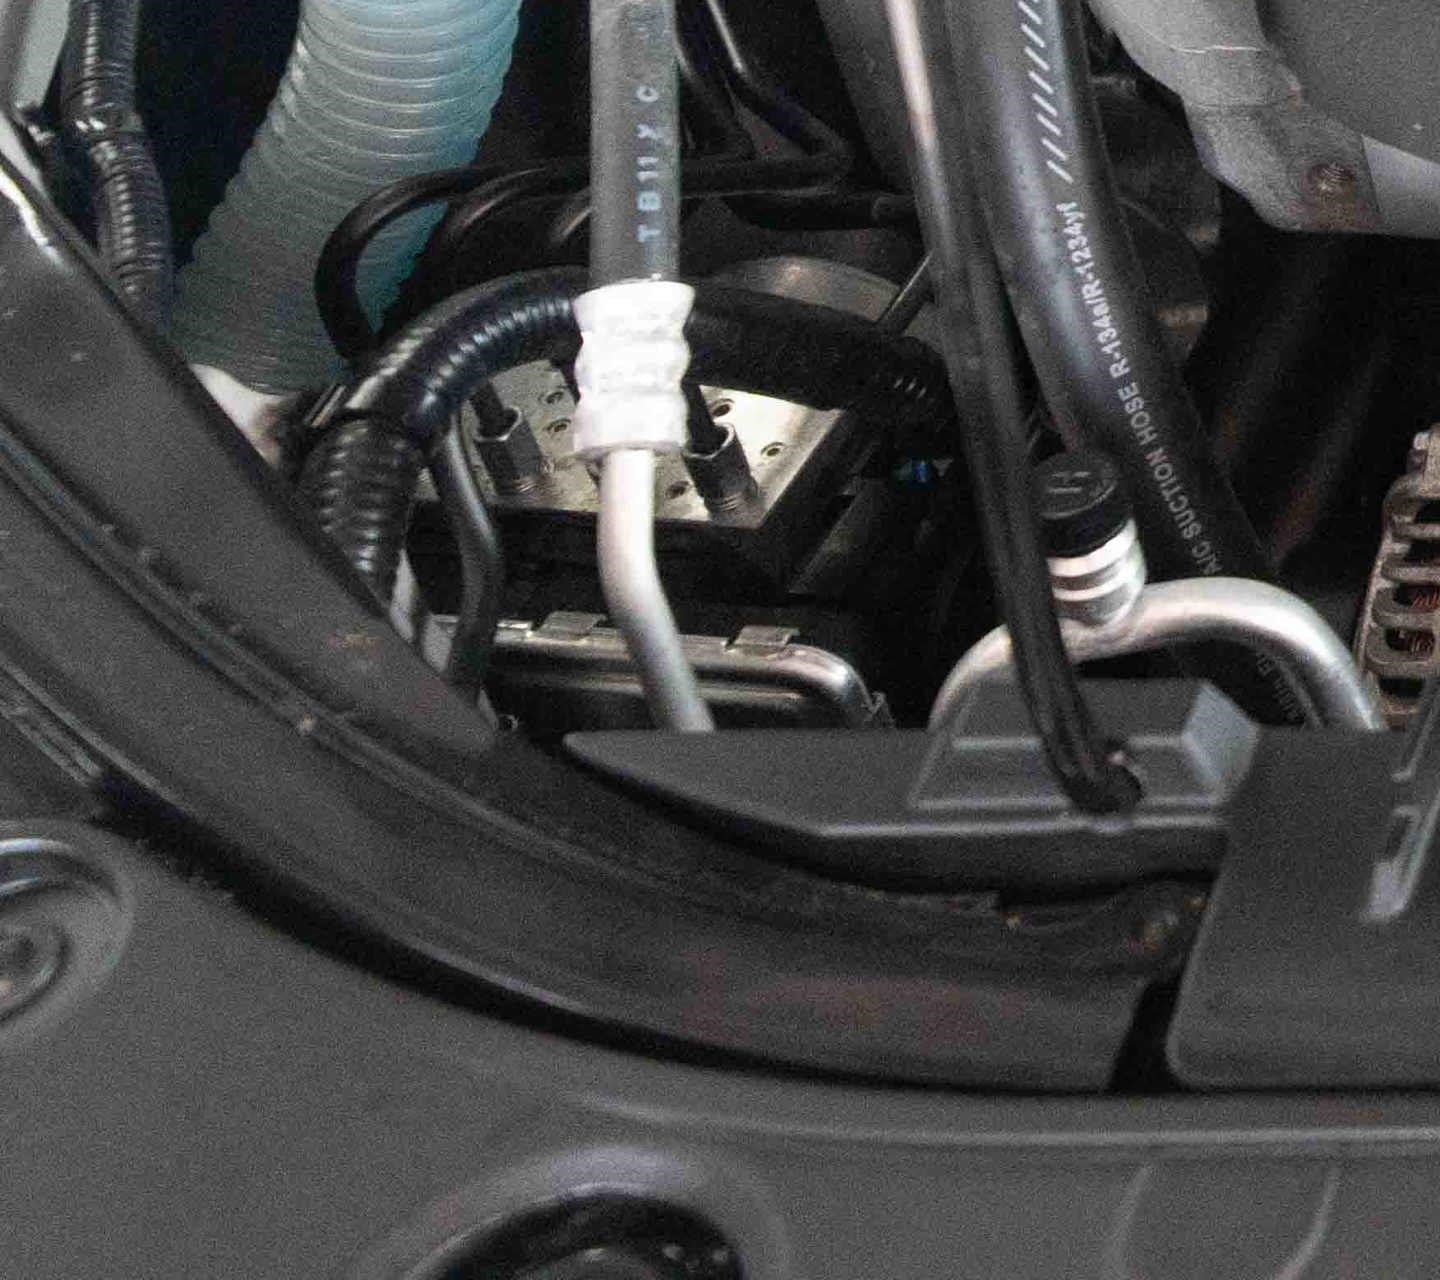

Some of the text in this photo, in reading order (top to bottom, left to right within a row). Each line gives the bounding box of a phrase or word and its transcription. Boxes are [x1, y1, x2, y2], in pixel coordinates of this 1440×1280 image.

[1117, 382, 1158, 445] HOSE
[1146, 446, 1202, 539] SUCTION
[1191, 541, 1223, 576] A/C
